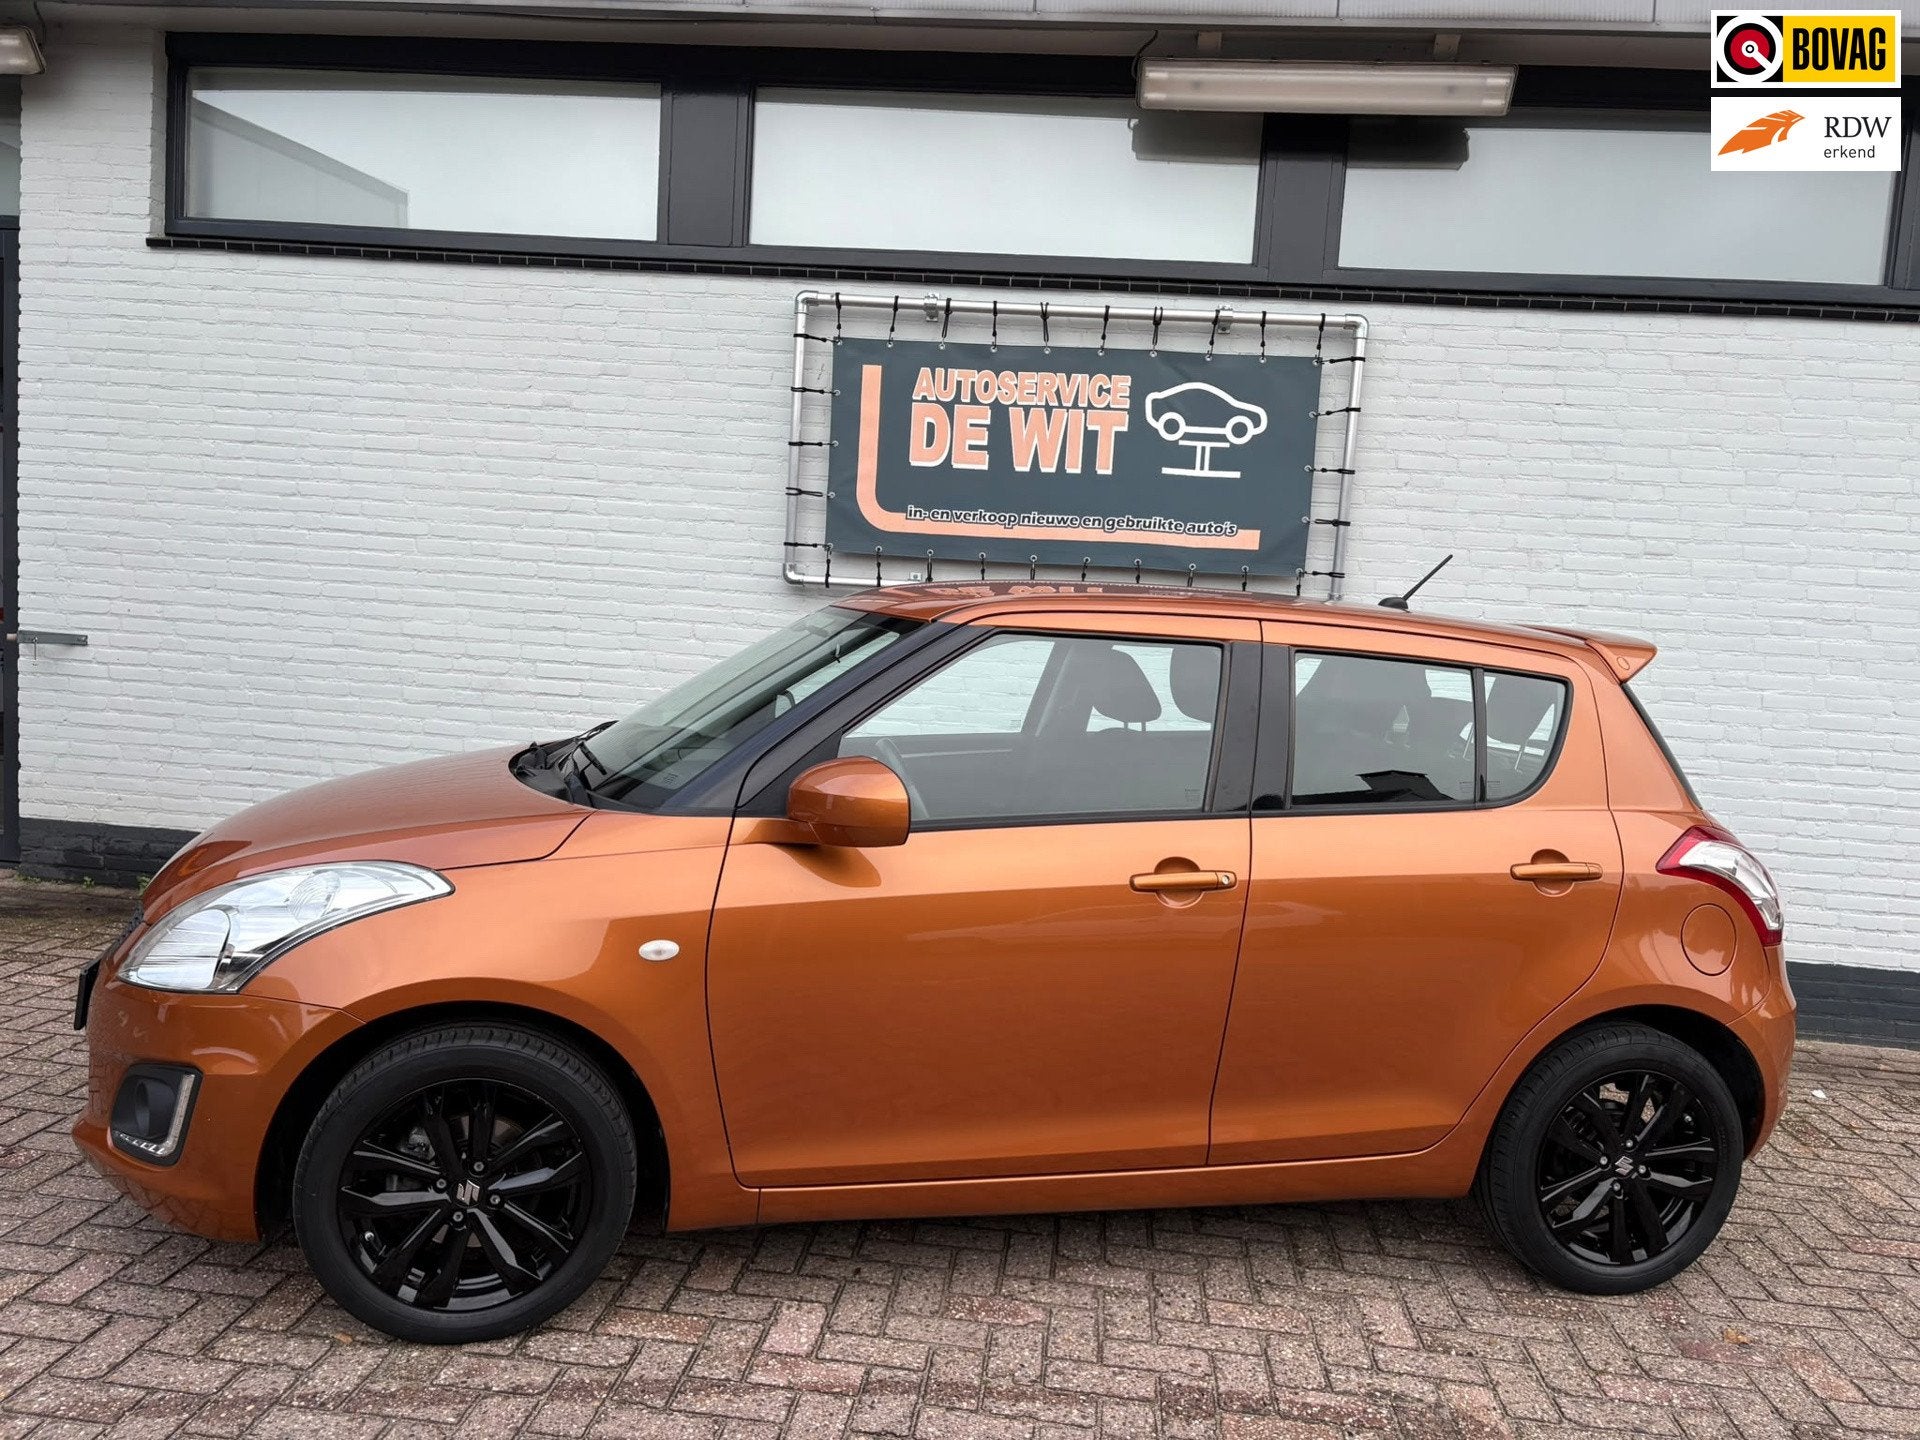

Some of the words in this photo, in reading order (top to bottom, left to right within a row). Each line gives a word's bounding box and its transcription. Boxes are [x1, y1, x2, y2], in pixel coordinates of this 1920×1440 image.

[912, 367, 1131, 408] AUTOSERVICE
[909, 403, 990, 470] DE
[1008, 407, 1129, 475] WIT
[907, 505, 928, 520] in-
[929, 507, 950, 521] en
[952, 509, 1018, 528] verkoop
[1020, 512, 1079, 527] nieuwe
[1081, 516, 1103, 529] en
[1105, 515, 1184, 533] gebruikte
[1185, 522, 1237, 536] auto's
